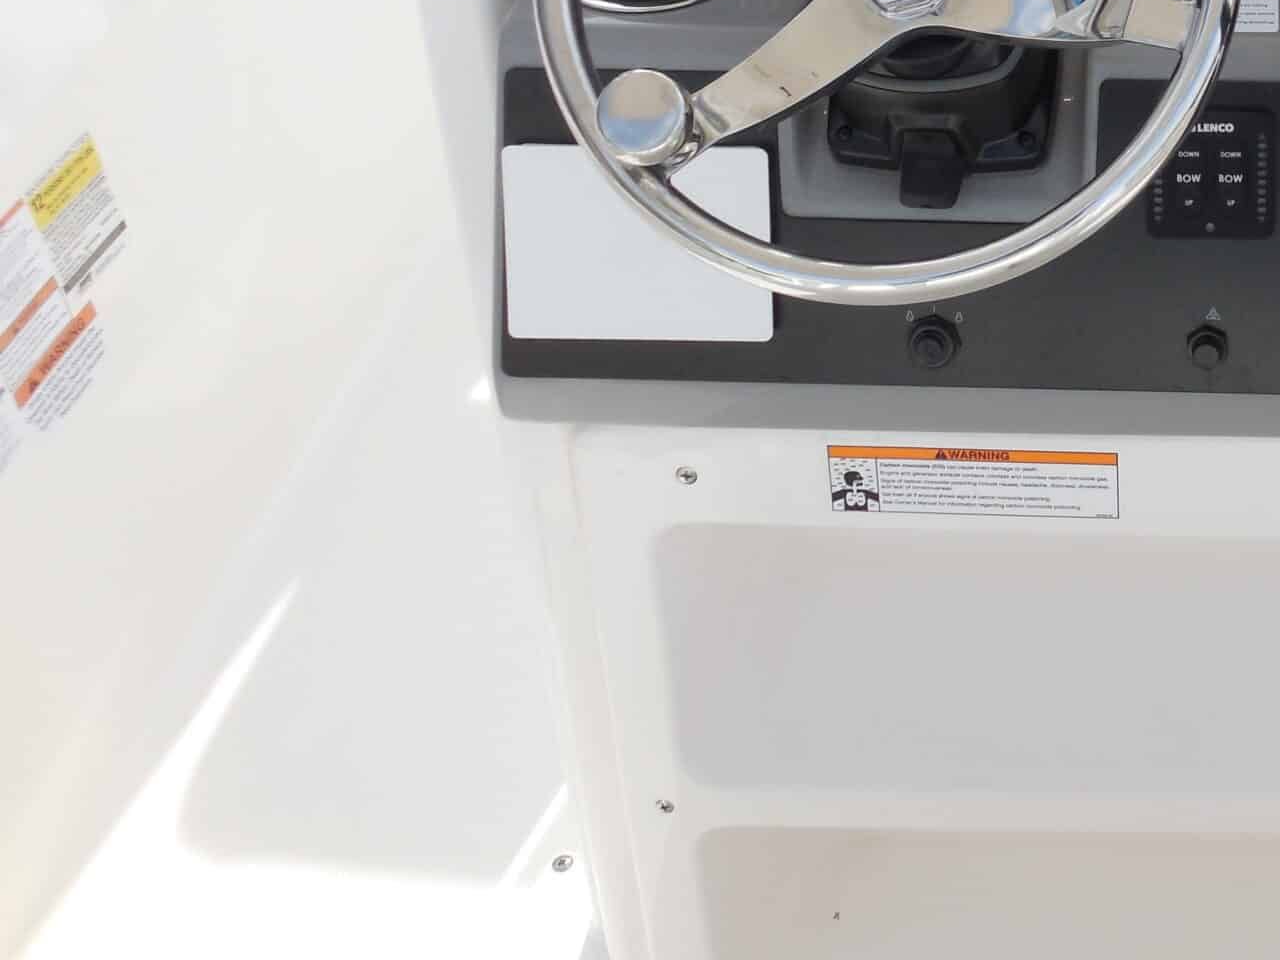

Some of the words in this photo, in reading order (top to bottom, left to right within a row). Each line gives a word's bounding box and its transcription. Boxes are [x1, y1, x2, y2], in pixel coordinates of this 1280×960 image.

[1197, 122, 1235, 133] LENCO
[1176, 173, 1201, 183] BOW
[1218, 174, 1243, 184] BOW
[947, 449, 1011, 461] WARNING
